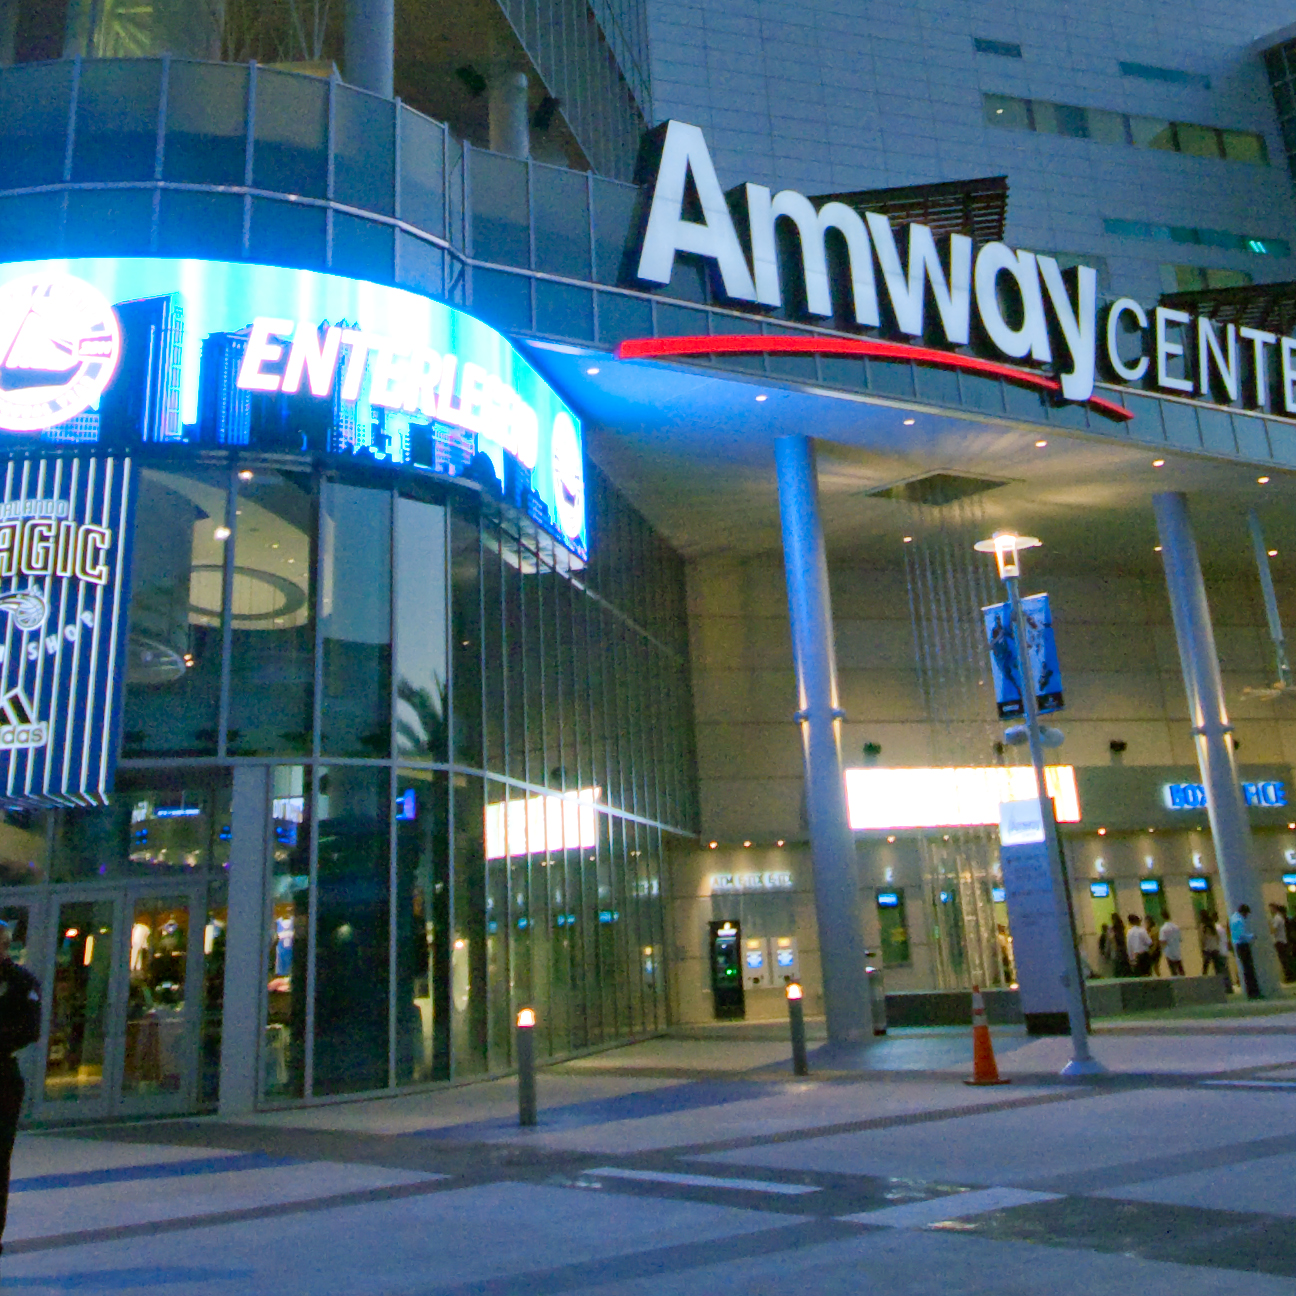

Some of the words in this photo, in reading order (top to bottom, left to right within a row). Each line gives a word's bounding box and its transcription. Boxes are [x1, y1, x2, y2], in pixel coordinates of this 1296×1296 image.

[637, 119, 1097, 401] Amway
[27, 610, 94, 661] SHOP
[1167, 782, 1208, 808] BOX
[1242, 780, 1289, 807] FICE
